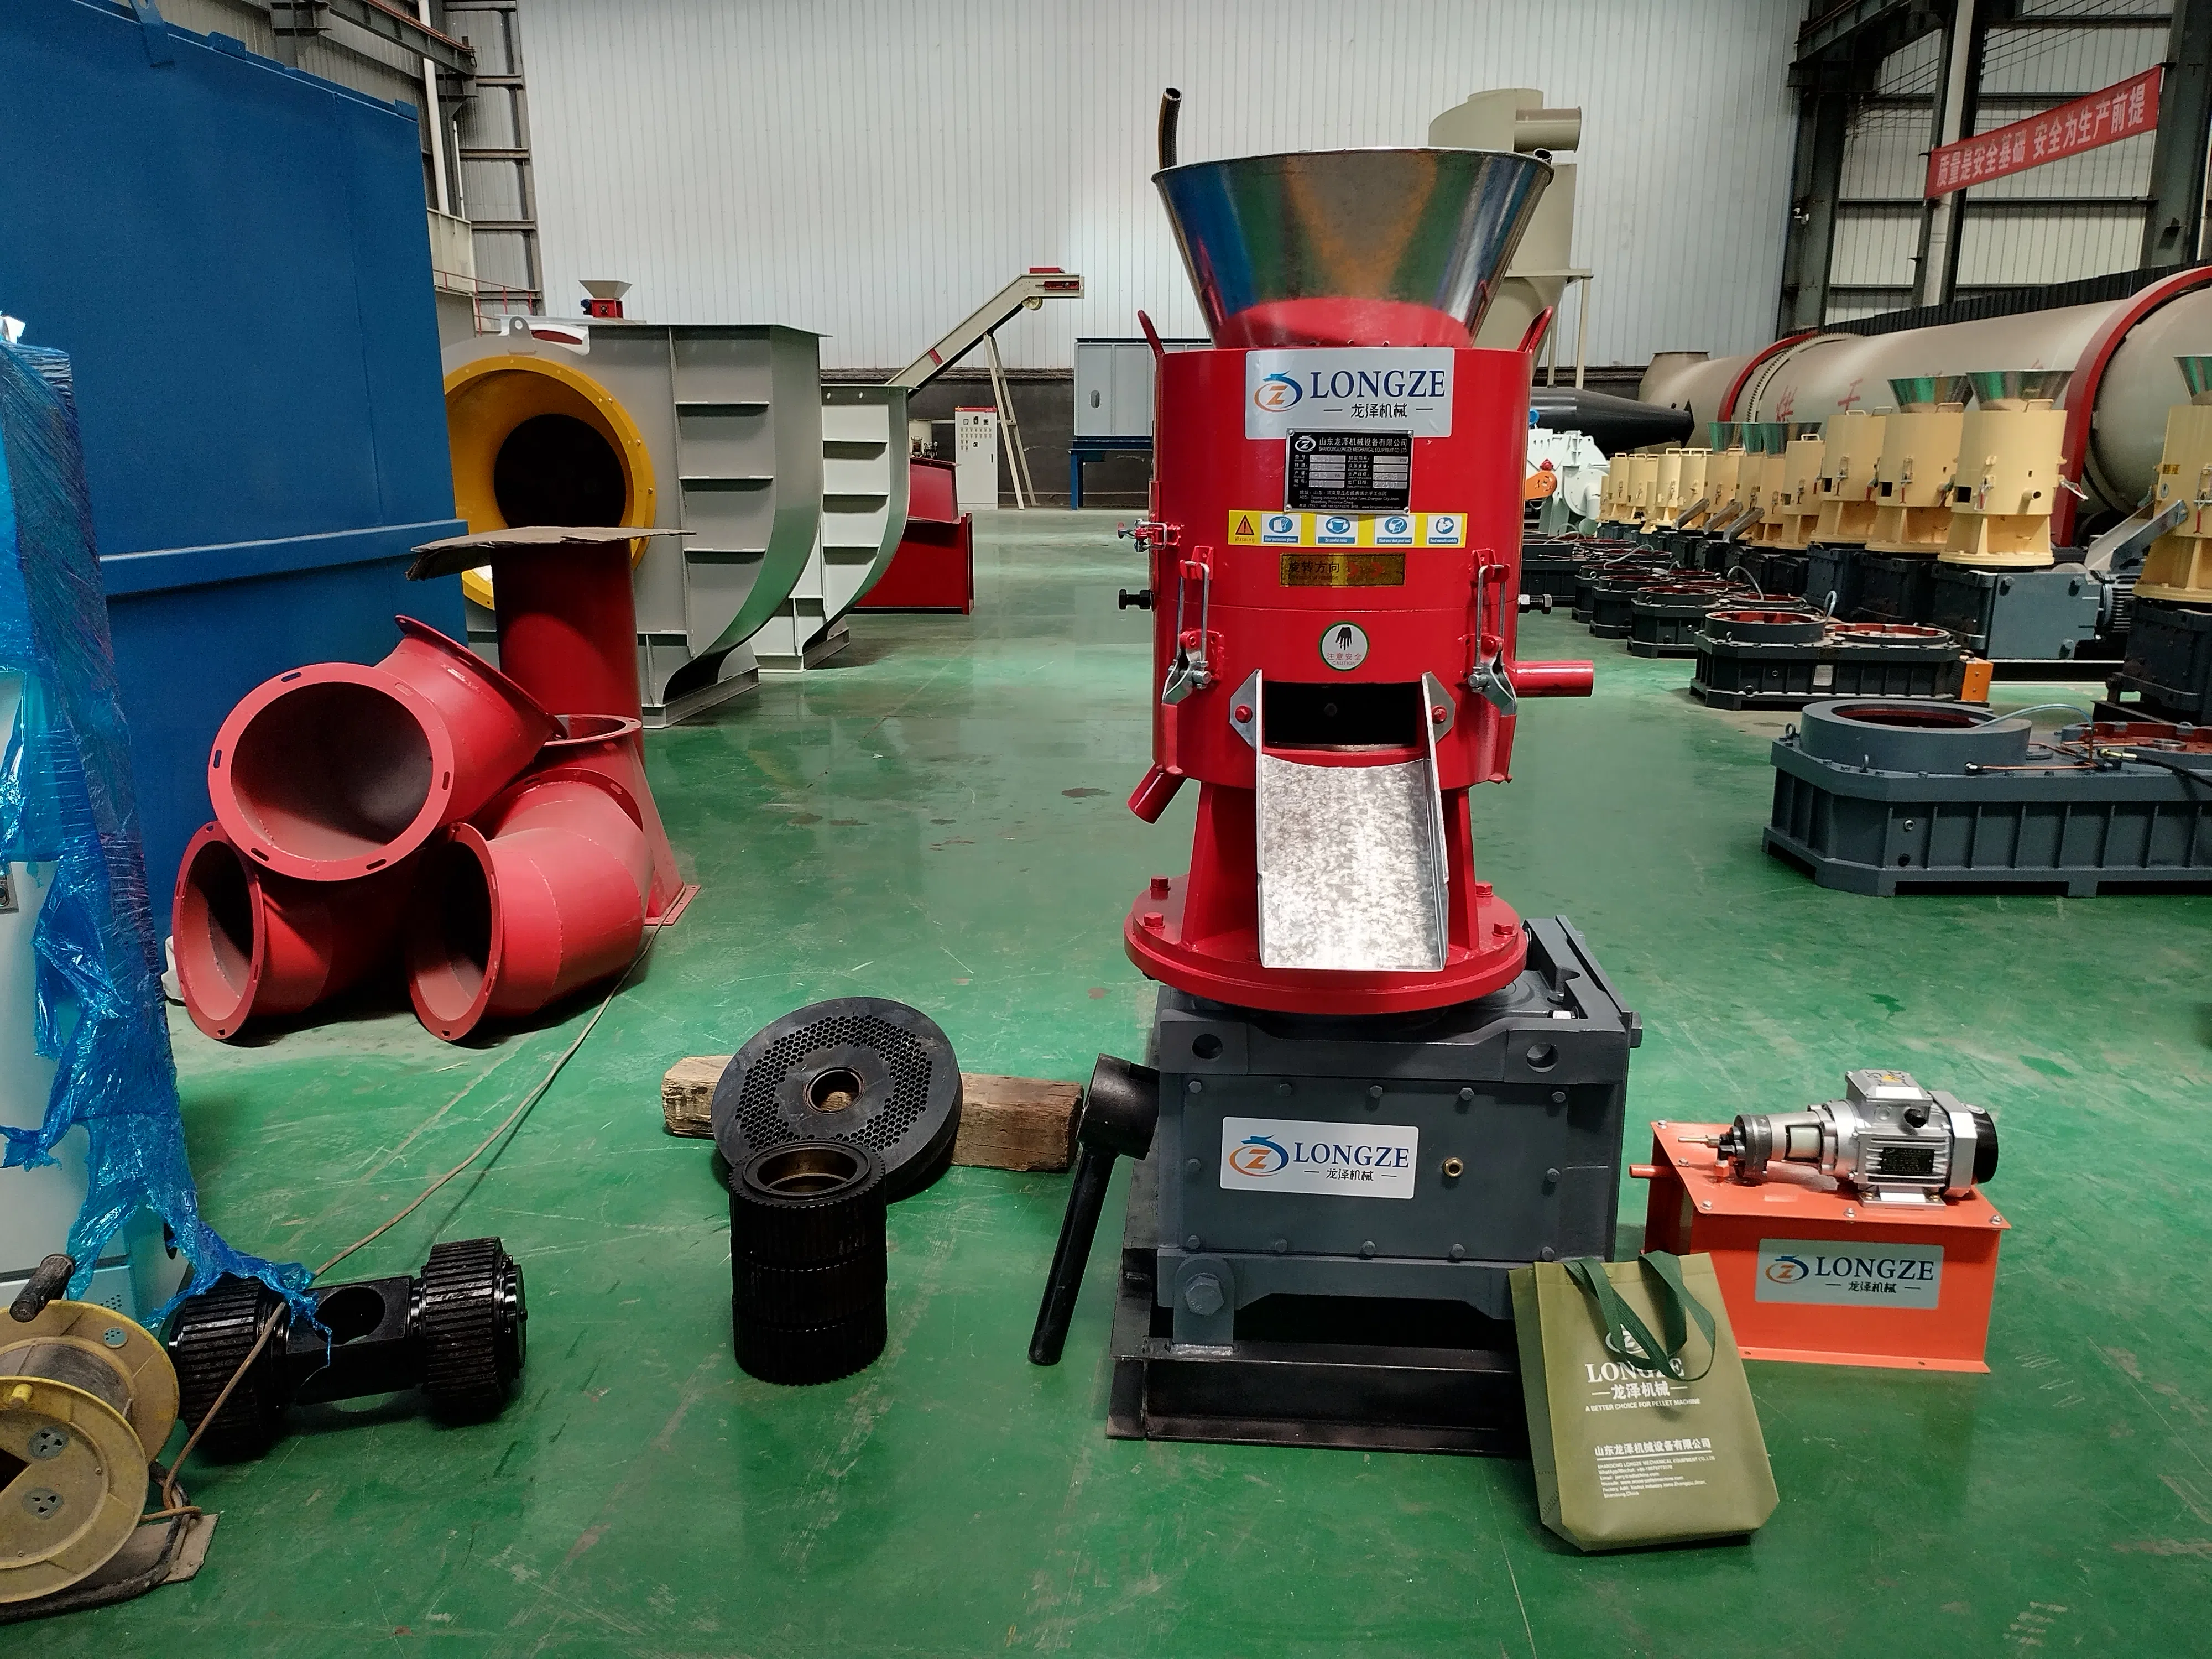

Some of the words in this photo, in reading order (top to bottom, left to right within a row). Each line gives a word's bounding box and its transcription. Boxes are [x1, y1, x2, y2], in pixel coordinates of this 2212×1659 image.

[1937, 129, 2027, 188] 质量是安全基础
[2032, 83, 2146, 160] 安全为生产前提
[1310, 370, 1446, 399] LONGZE
[1350, 403, 1408, 418] 龙泽机械
[1319, 437, 1407, 447] 山东龙泽机械设备有限公司
[1288, 561, 1339, 573] 旋转方向
[1327, 653, 1361, 661] 注意安全
[1293, 1142, 1410, 1168] LONGZE
[1326, 1168, 1374, 1181] 龙泽机械
[1814, 1256, 1934, 1281] LONGZE
[1848, 1281, 1897, 1294] 龙泽机械
[1610, 1380, 1670, 1400] 龙泽机械
[1615, 1402, 1638, 1410] CHOICE
[1673, 1397, 1701, 1406] MACHINE
[1594, 1438, 1712, 1456] 山东龙泽机械设备有限公司
